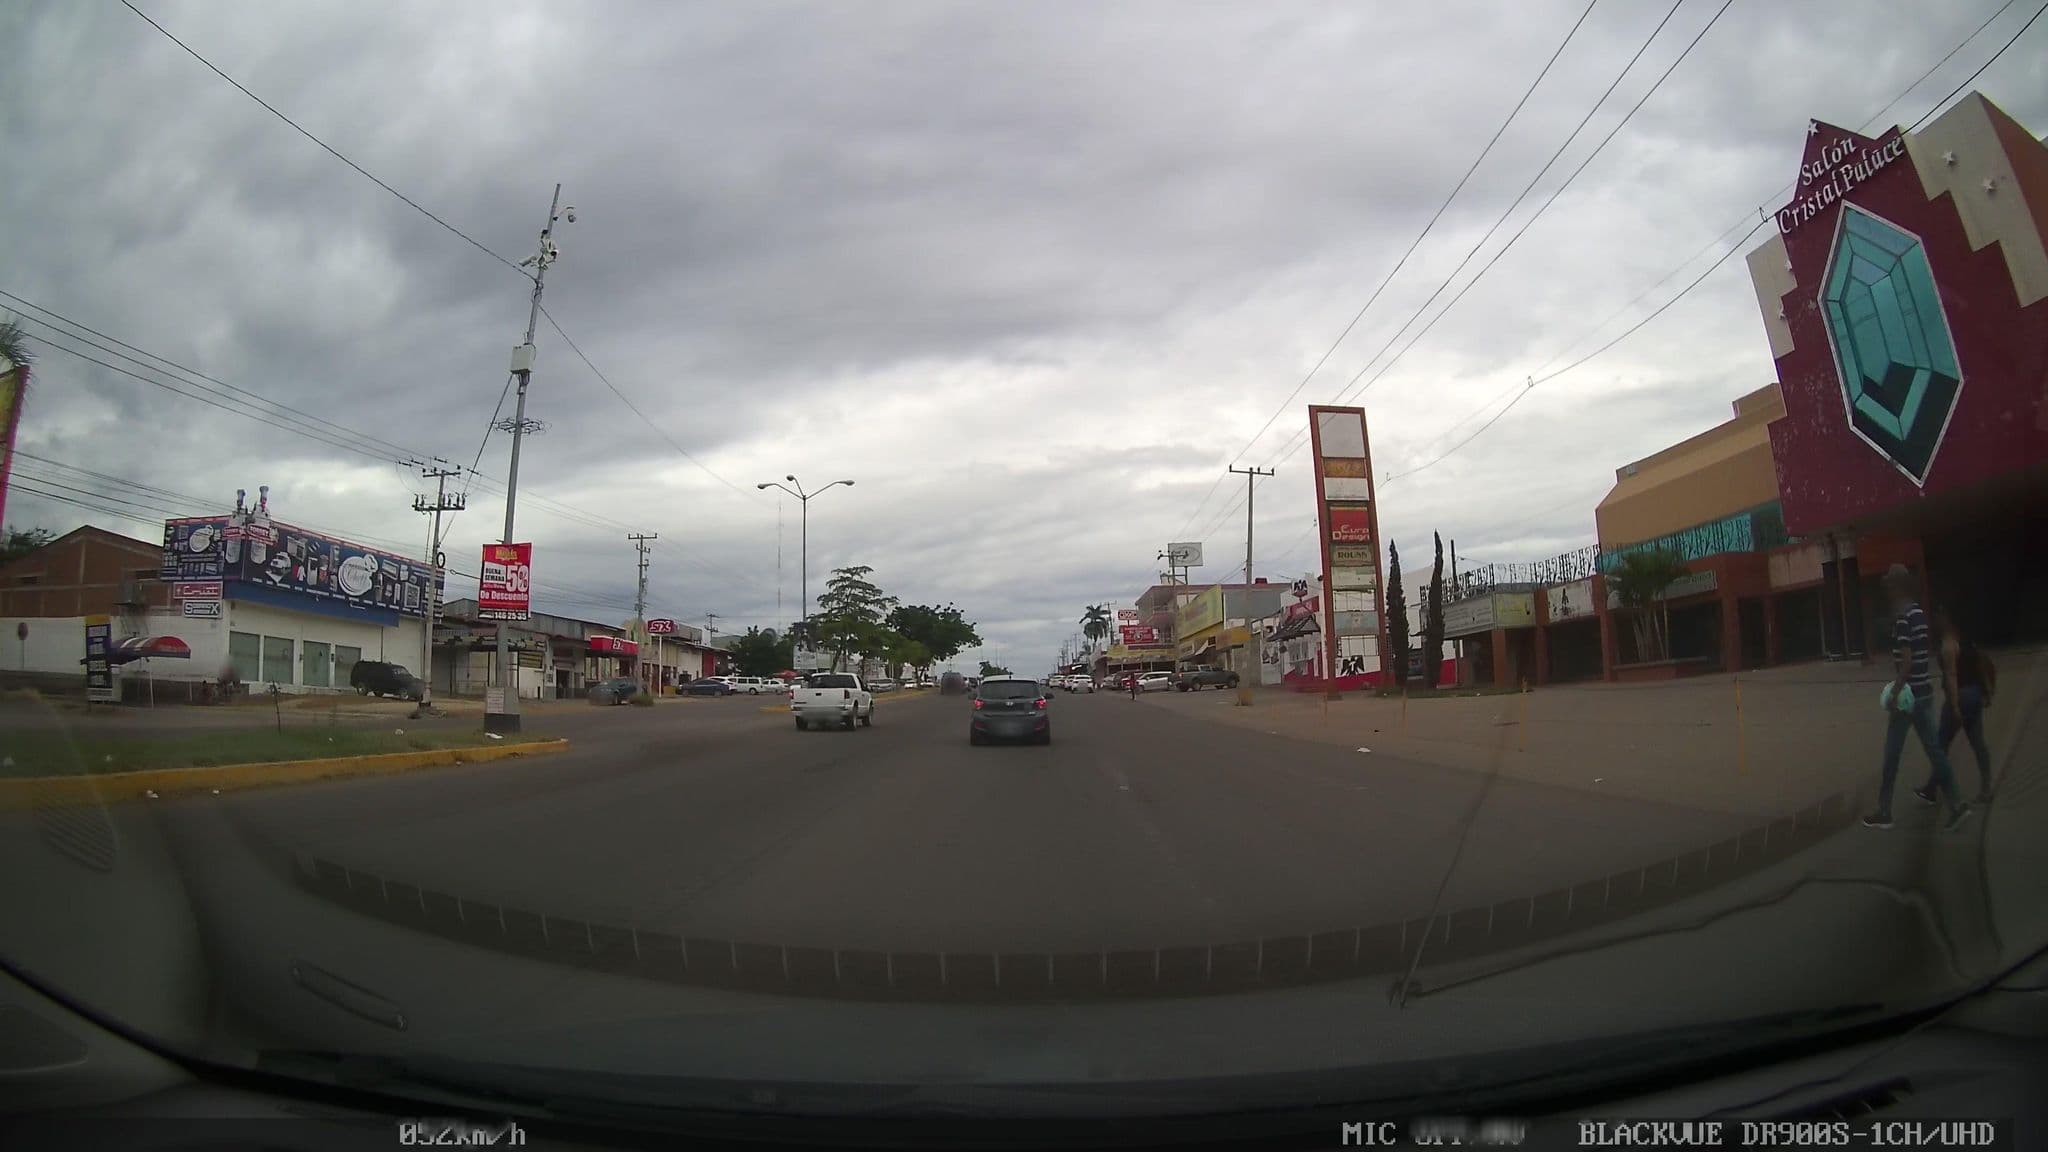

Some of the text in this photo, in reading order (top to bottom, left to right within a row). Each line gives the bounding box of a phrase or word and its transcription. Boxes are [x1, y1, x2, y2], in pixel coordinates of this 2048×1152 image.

[1779, 136, 1905, 234] Cristal Palace
[1801, 137, 1858, 186] Salón
[480, 591, 528, 601] De Descuento
